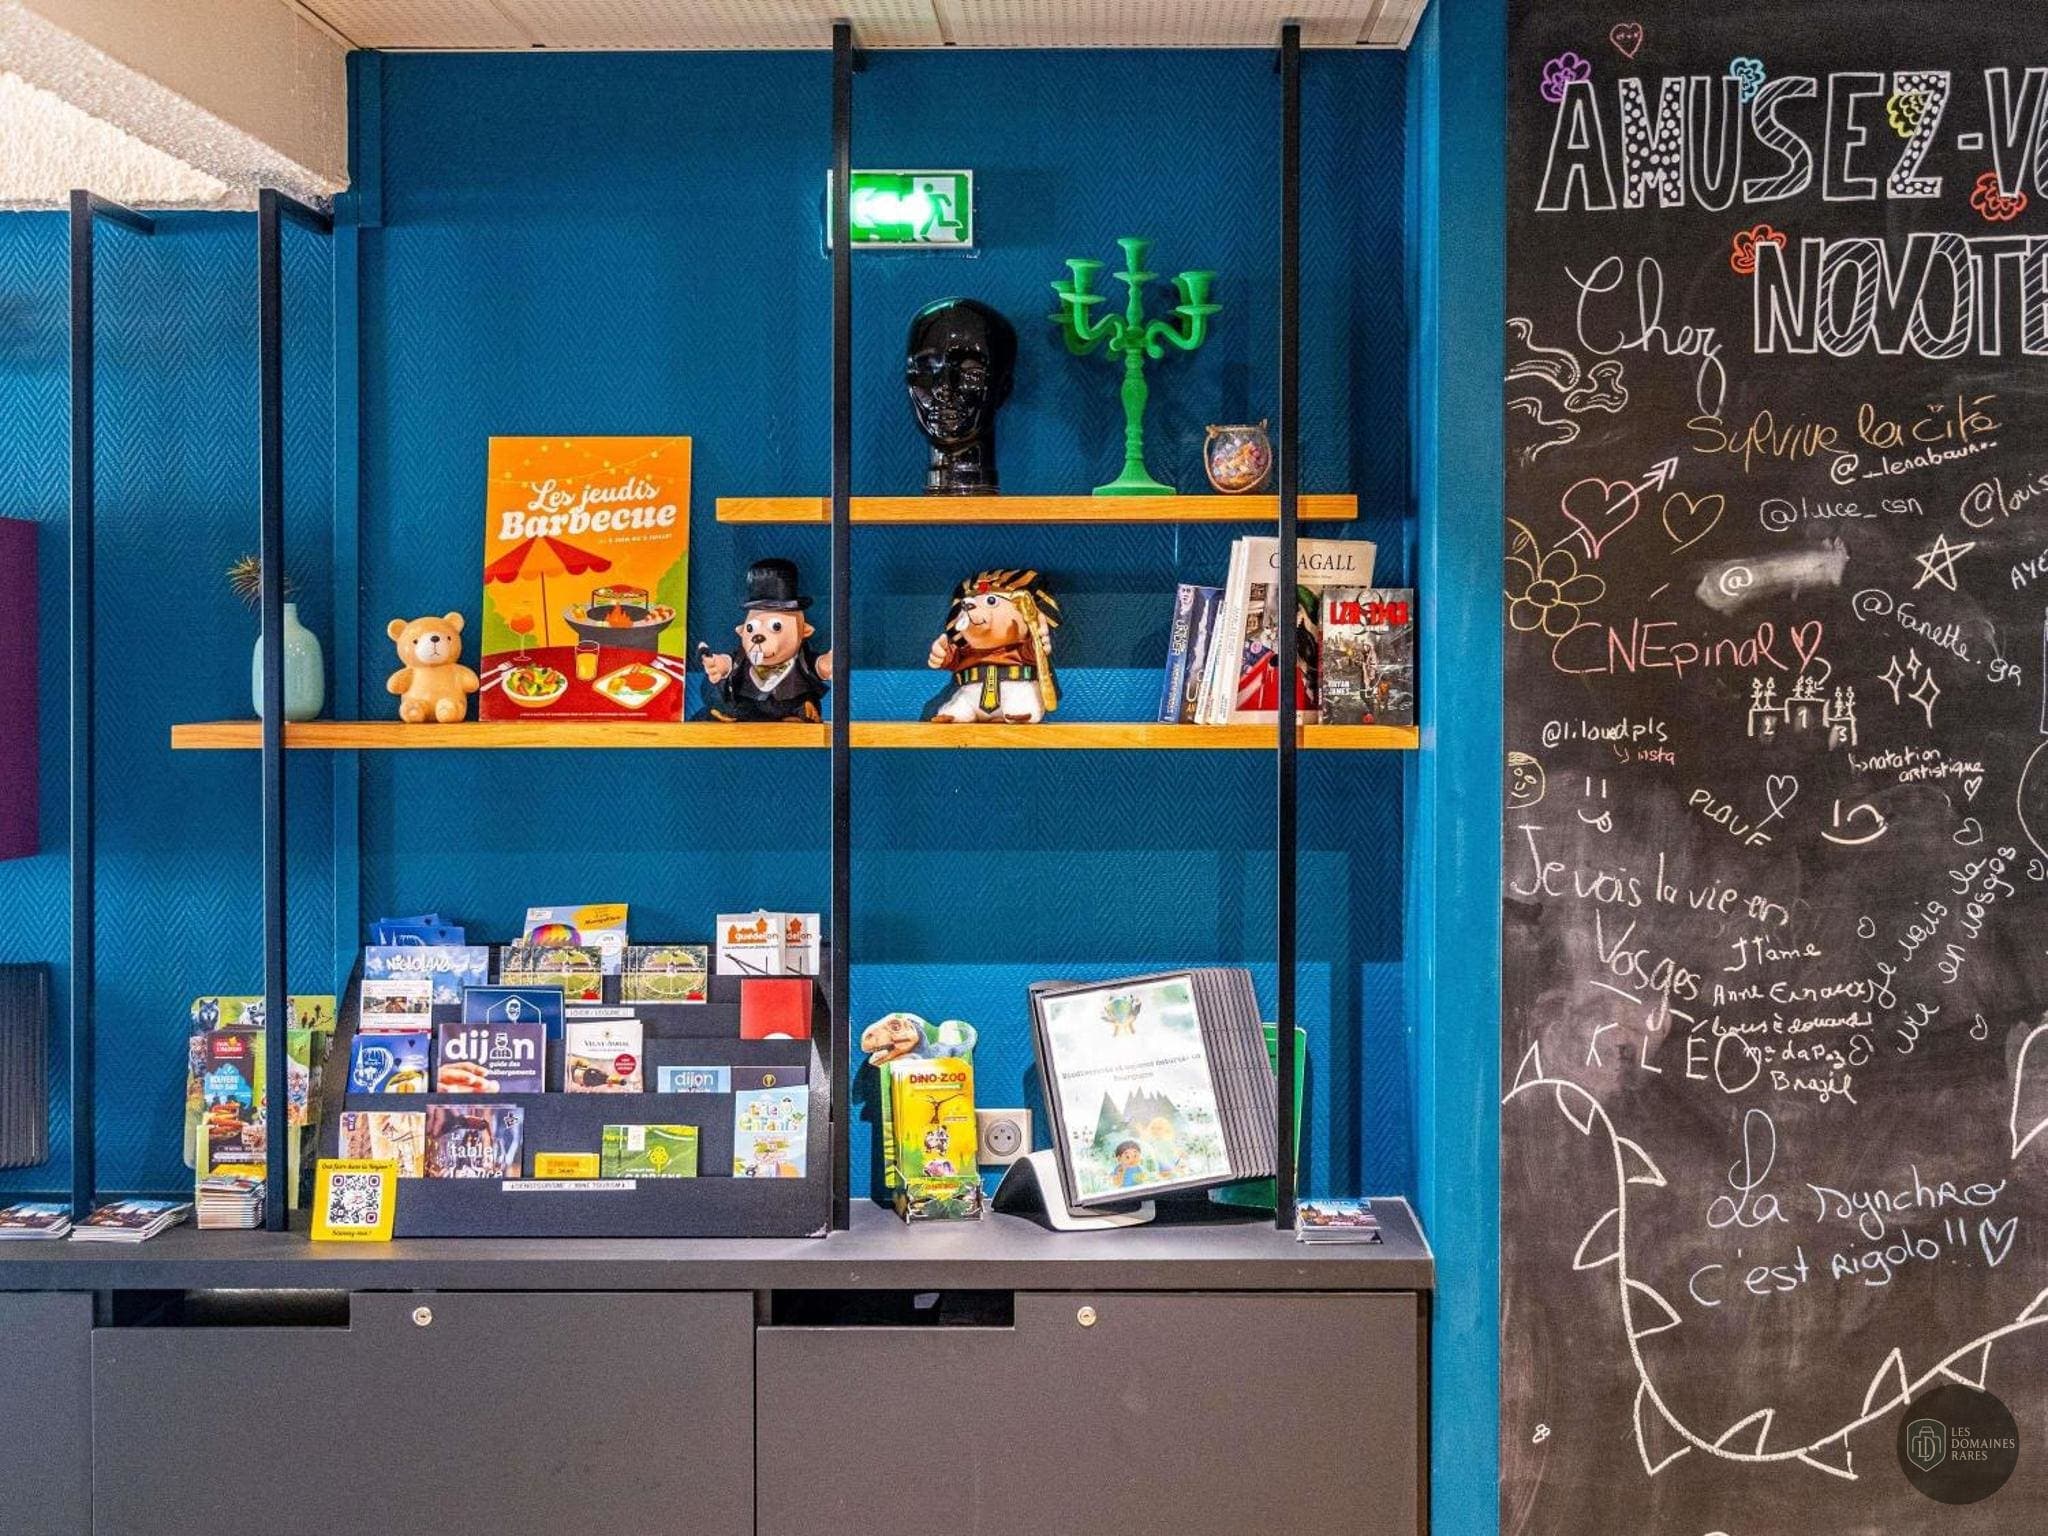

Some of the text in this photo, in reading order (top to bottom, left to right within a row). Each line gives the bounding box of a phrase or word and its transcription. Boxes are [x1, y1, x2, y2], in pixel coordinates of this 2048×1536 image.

[527, 476, 661, 515] Les jeudis
[498, 503, 679, 541] Barbecue
[1269, 552, 1357, 572] CAGALL
[1510, 823, 1565, 897] Je
[1574, 866, 1642, 908] vois
[1655, 851, 1679, 903] la
[1688, 879, 1738, 914] vie
[1594, 907, 1701, 1032] Vosges
